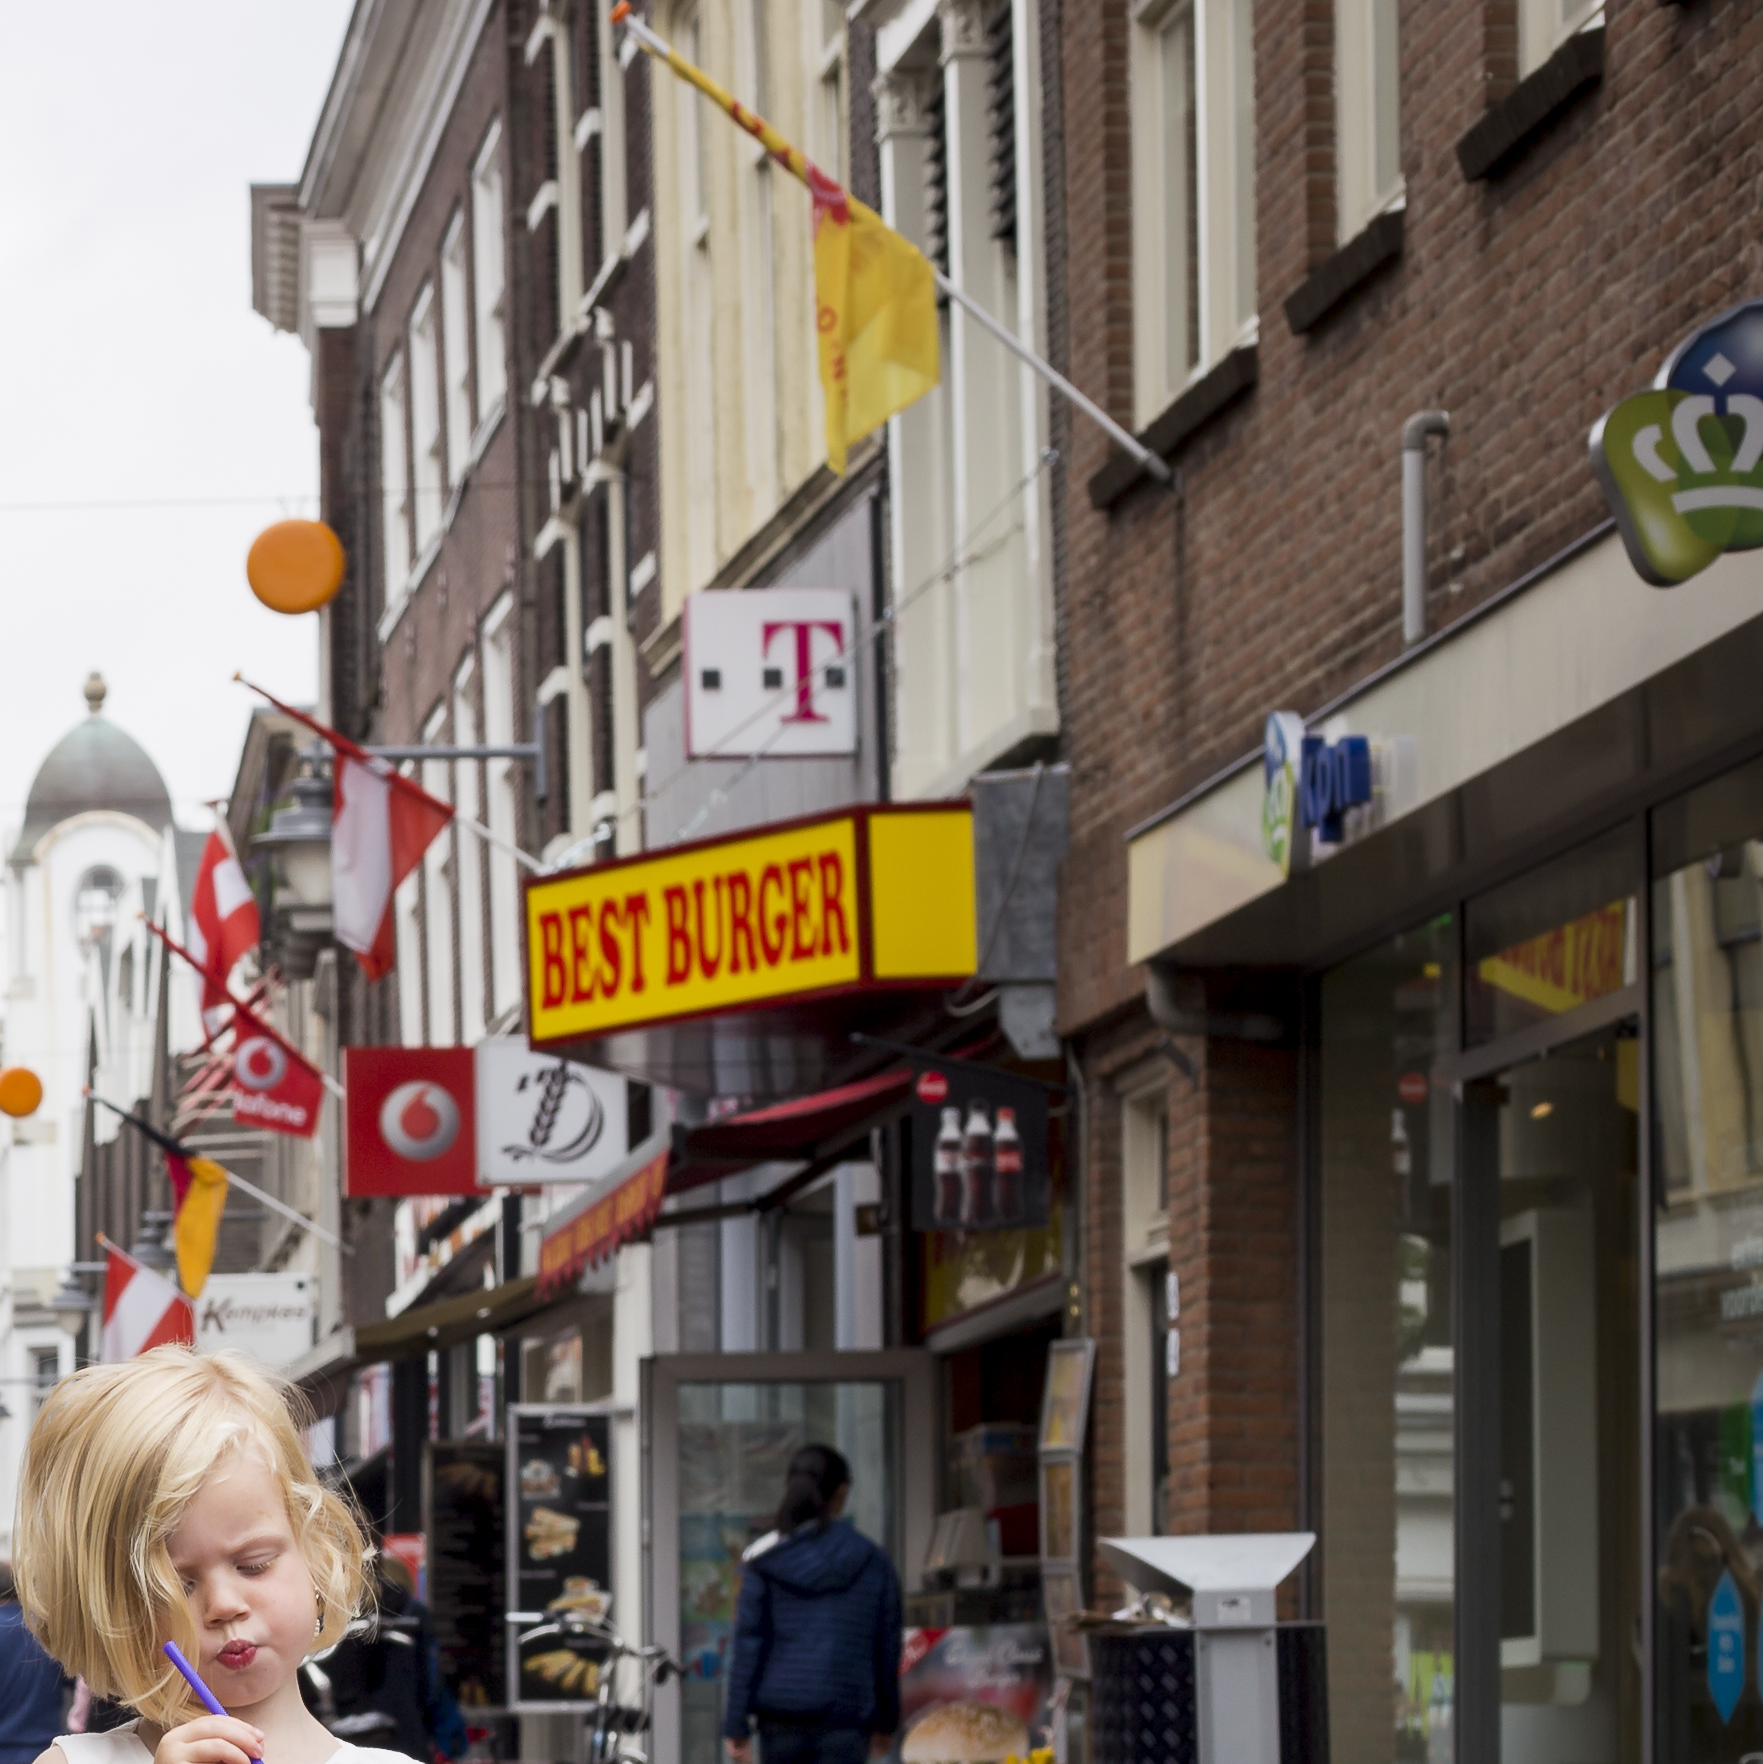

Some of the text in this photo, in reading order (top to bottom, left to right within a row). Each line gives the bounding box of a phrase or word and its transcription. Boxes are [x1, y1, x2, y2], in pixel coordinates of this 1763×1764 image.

[761, 620, 845, 724] T
[539, 849, 851, 1012] BEST BURGER
